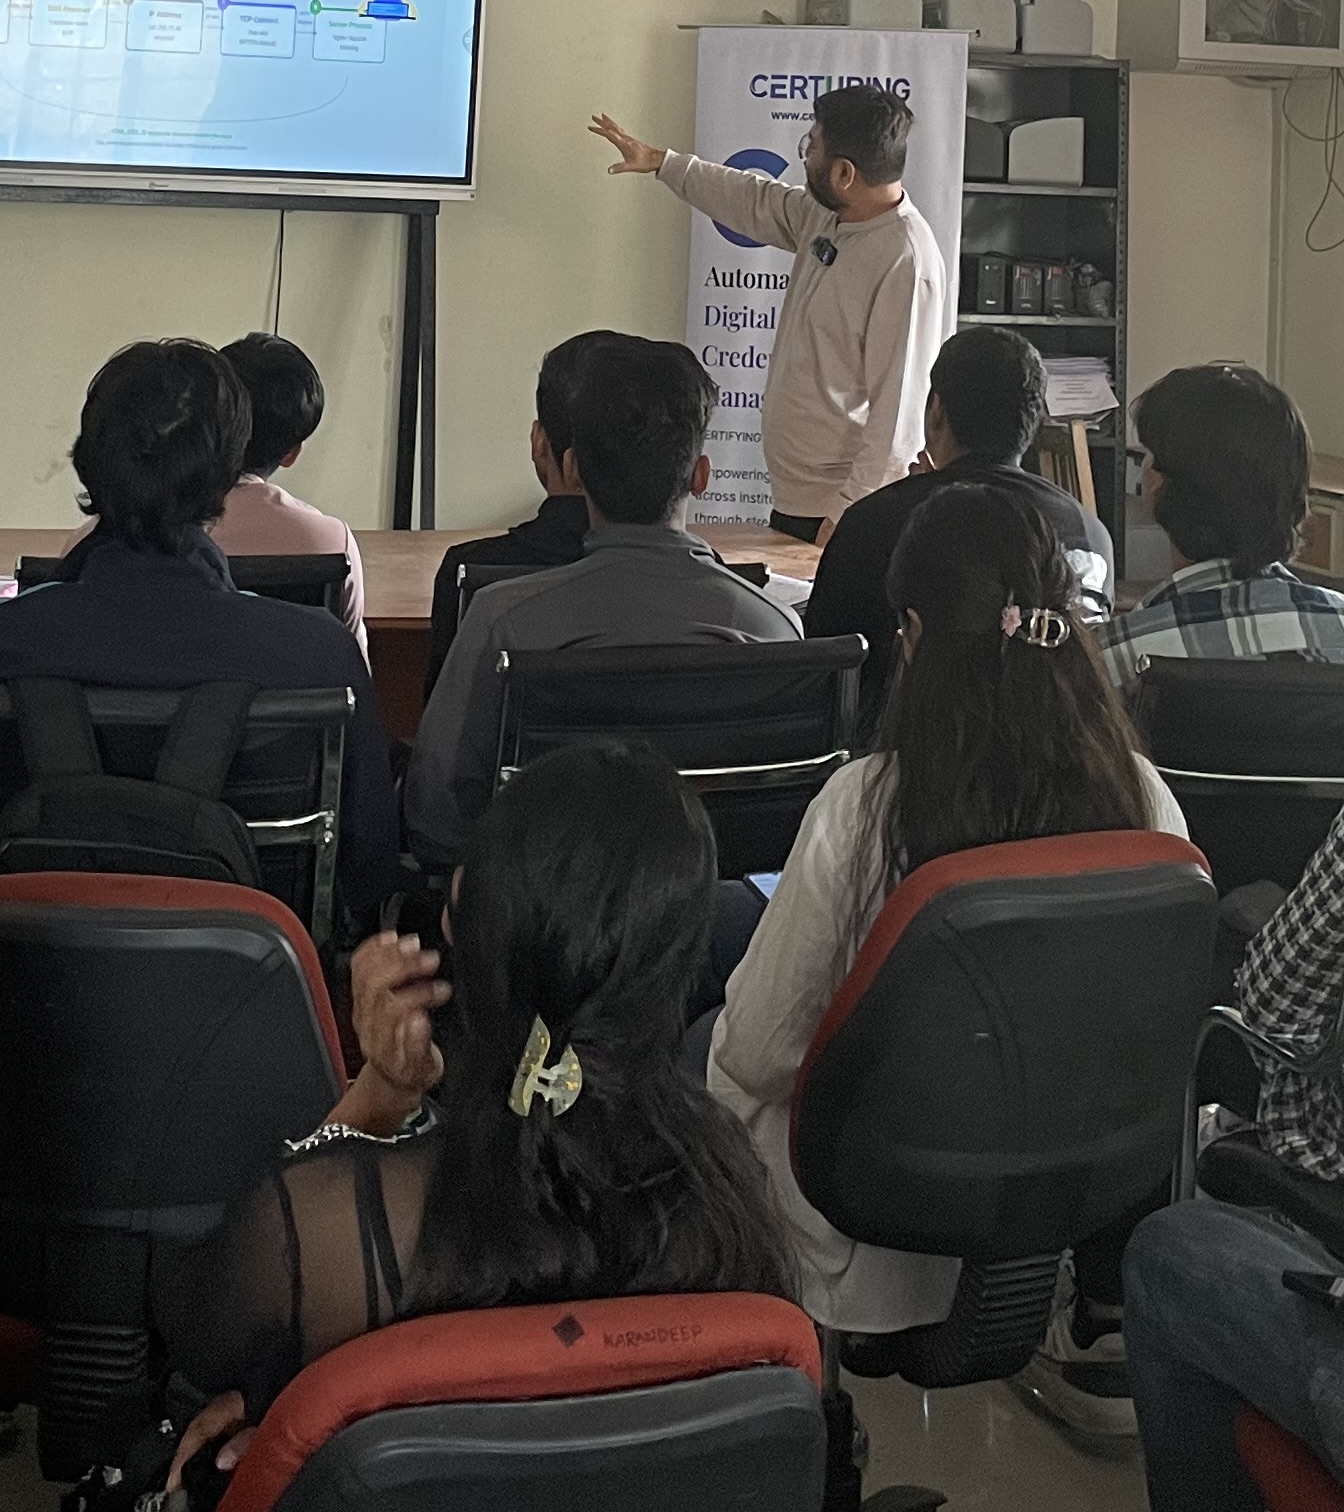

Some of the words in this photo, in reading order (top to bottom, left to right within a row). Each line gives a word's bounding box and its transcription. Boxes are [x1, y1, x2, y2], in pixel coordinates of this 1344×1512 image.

[704, 266, 790, 290] Automa
[704, 305, 776, 333] Digital
[716, 386, 765, 413] ana
